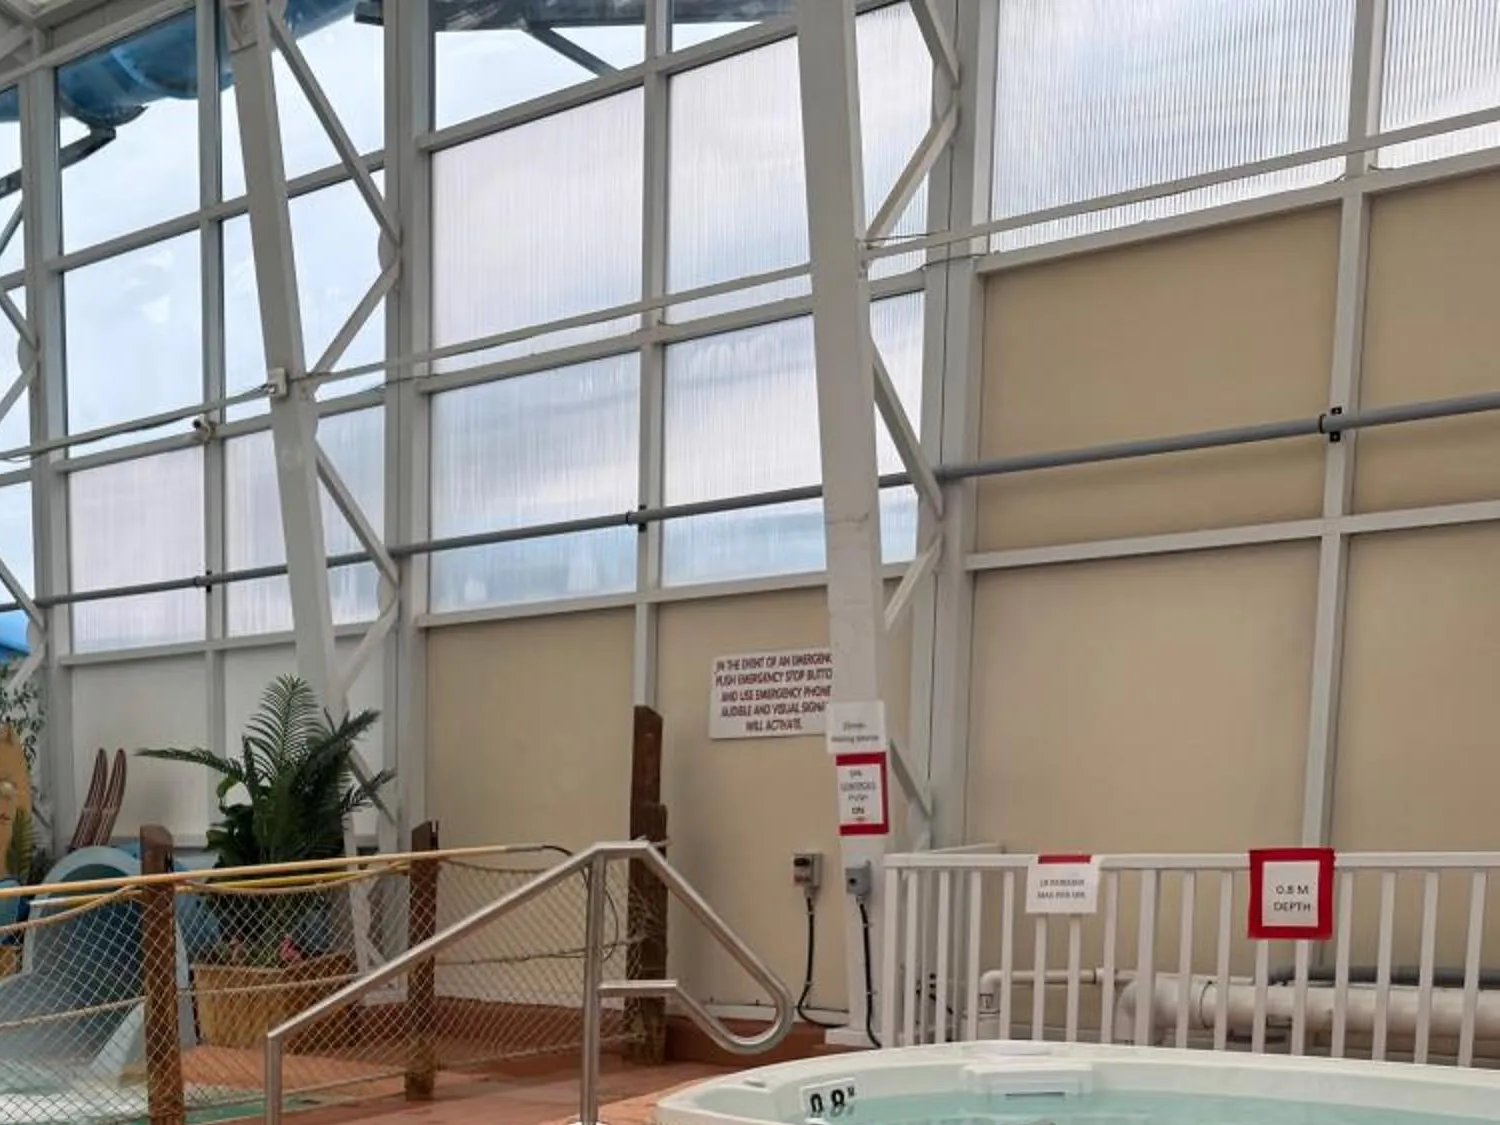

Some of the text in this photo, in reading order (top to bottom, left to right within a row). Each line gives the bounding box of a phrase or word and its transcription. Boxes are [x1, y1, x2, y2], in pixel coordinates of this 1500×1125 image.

[727, 659, 740, 670] THE
[766, 656, 777, 667] OF
[778, 655, 791, 666] AN
[792, 653, 832, 666] EMERGENC
[715, 668, 833, 686] PUSH EMERGENCY STOP BUTTO
[721, 691, 738, 702] AND
[740, 690, 754, 701] USE
[756, 687, 802, 700] EMERGENCY
[721, 705, 751, 717] AUDIBLE
[754, 704, 771, 715] AND
[772, 702, 800, 714] VISUAL
[745, 721, 763, 731] WILL
[1273, 901, 1311, 912] DEPTH
